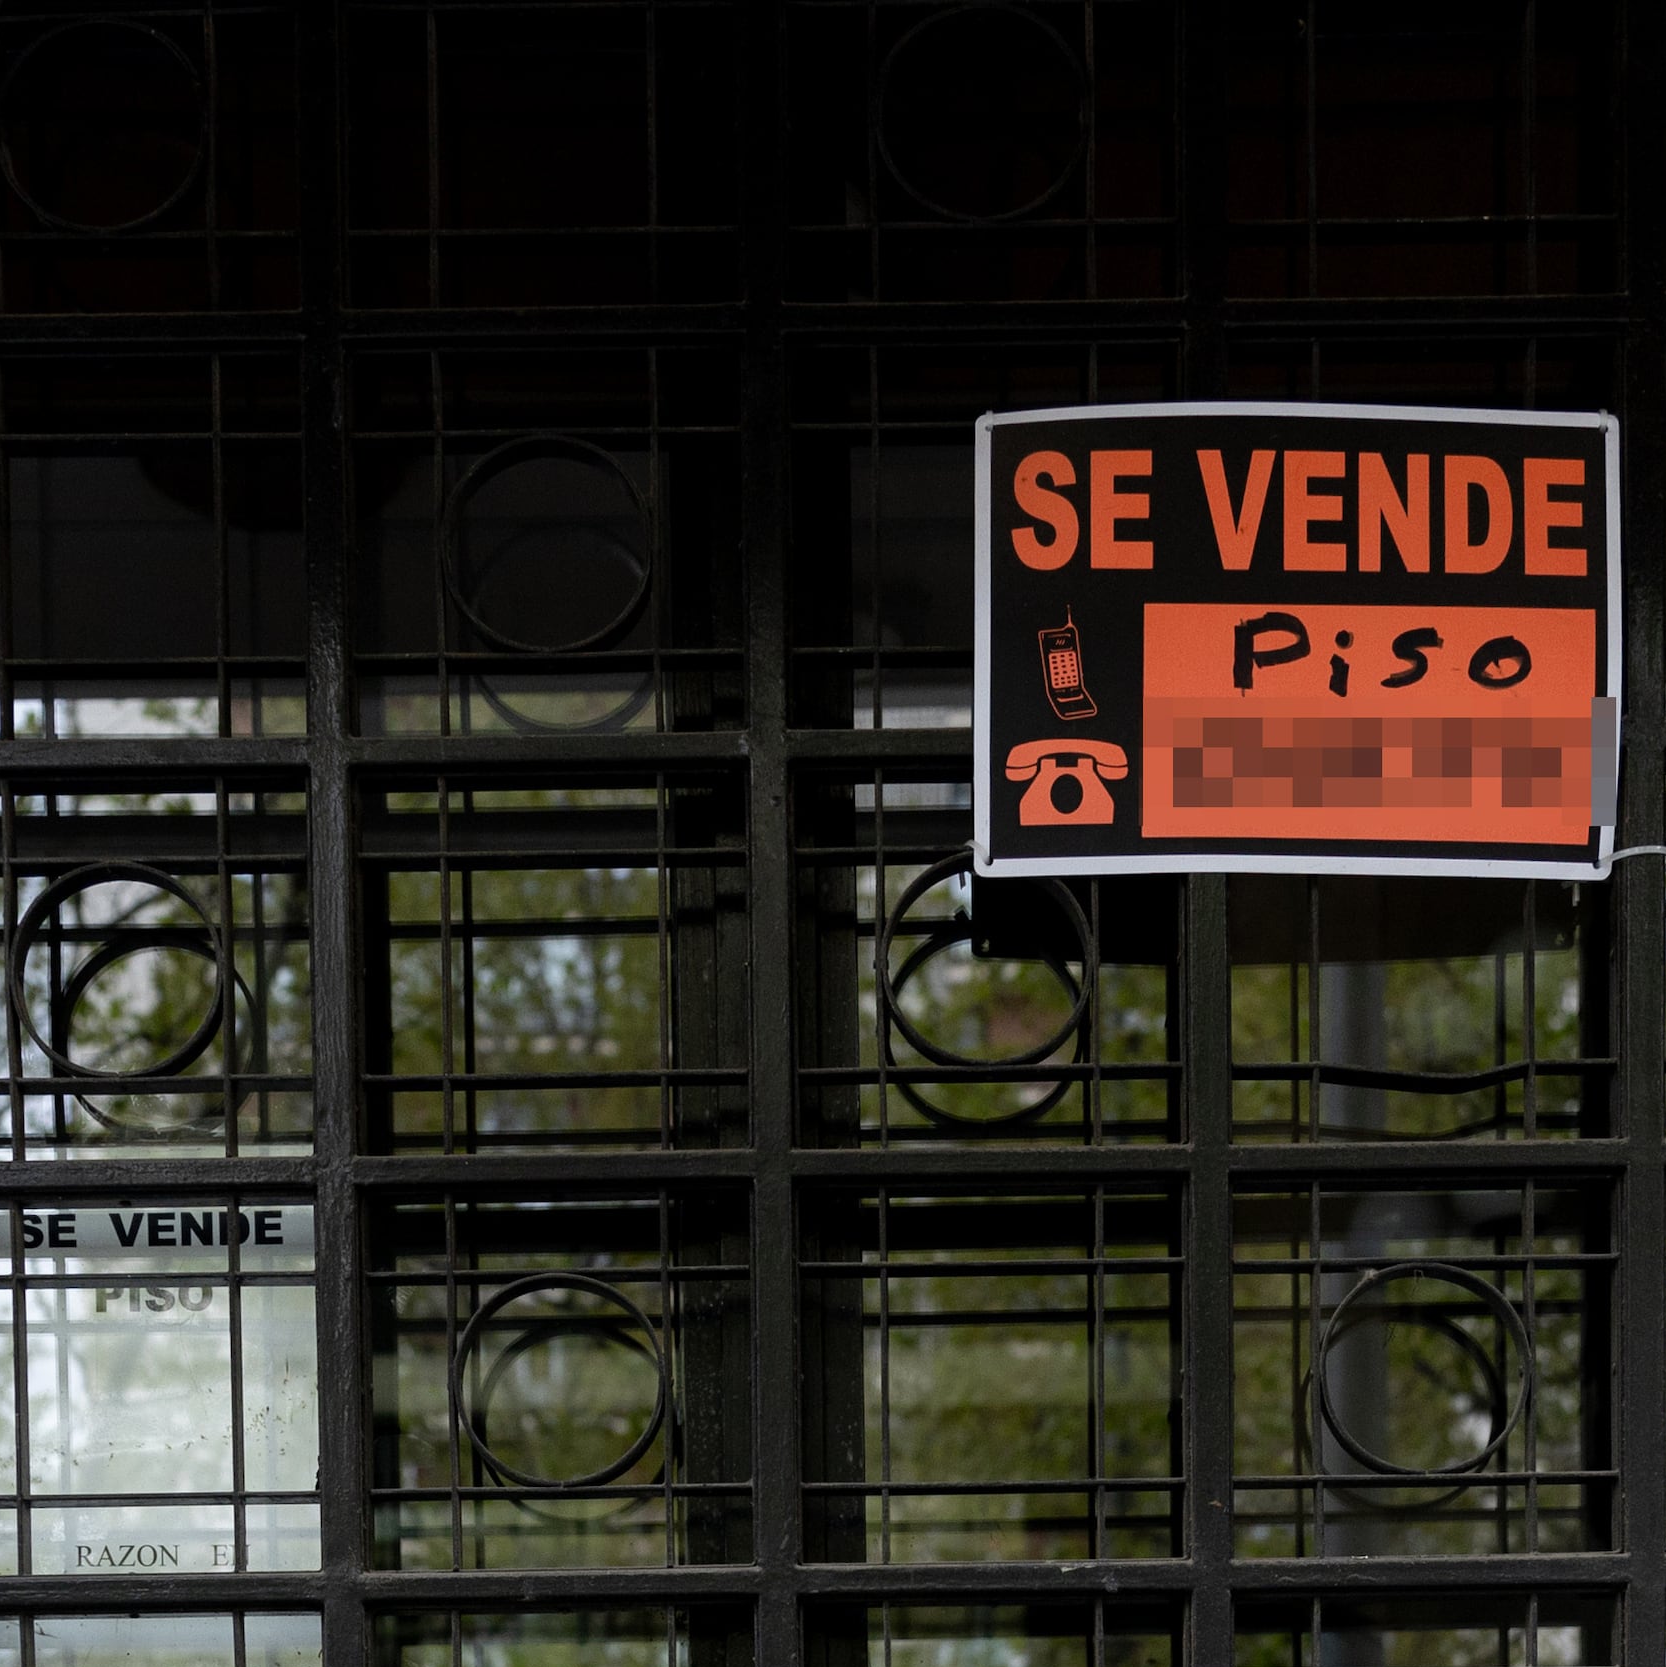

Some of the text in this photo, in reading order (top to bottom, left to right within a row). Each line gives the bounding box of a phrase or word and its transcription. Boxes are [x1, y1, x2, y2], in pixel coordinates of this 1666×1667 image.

[1011, 448, 1588, 577] SE VENDE
[22, 1210, 284, 1249] SE VENDE
[95, 1286, 214, 1313] PISO
[75, 1544, 180, 1568] RAZON
